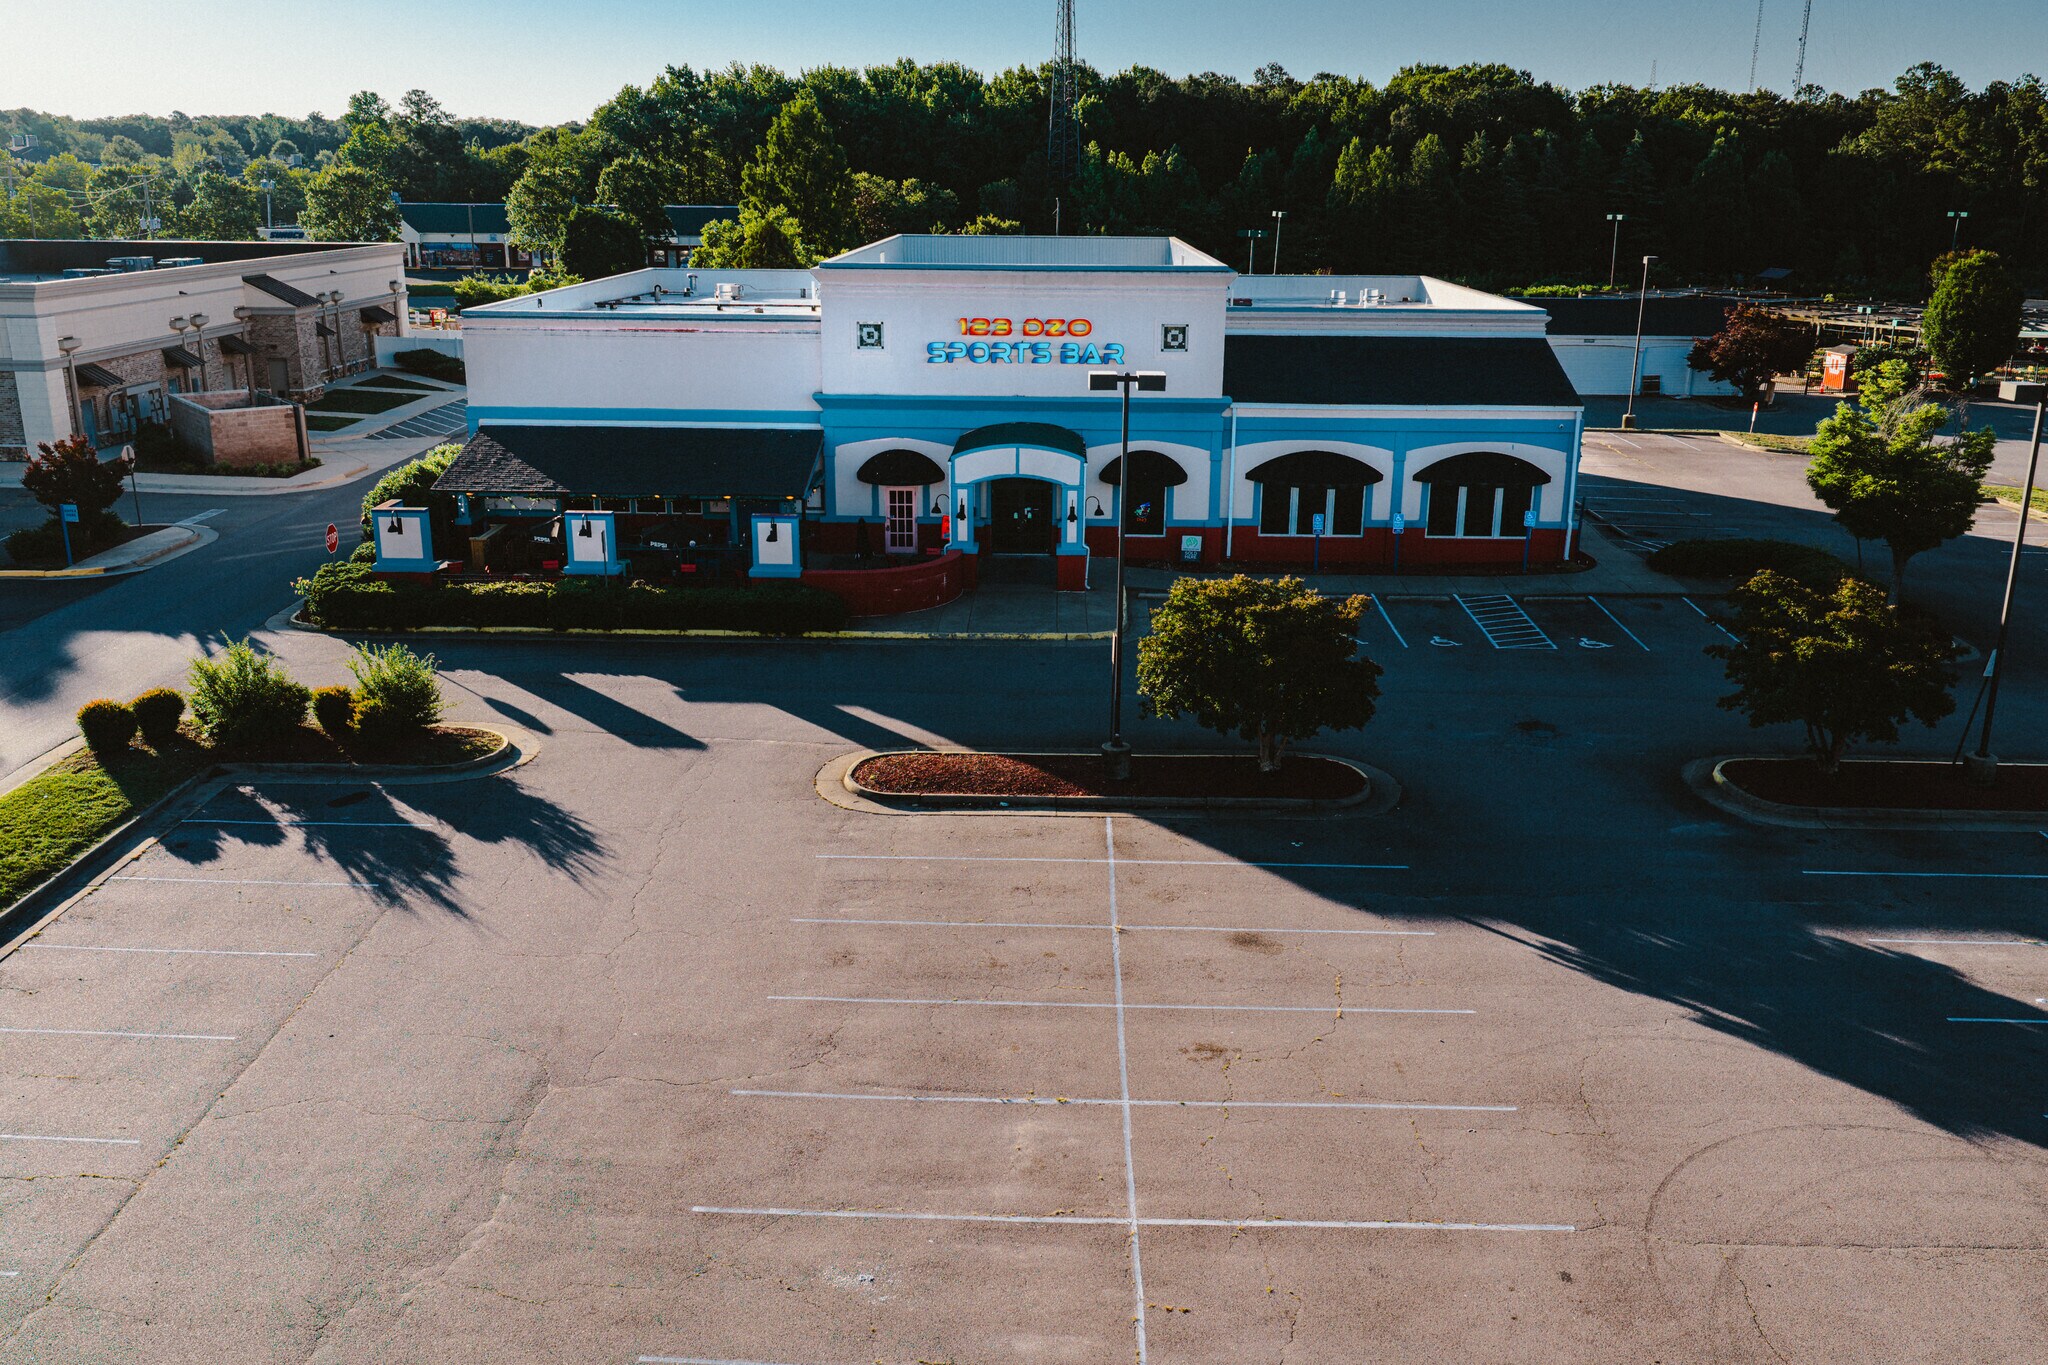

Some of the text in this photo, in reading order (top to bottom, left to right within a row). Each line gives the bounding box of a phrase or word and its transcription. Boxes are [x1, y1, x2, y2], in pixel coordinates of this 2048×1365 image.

[957, 317, 1093, 337] 123 DZO
[927, 341, 1125, 365] SPORTS BAR
[326, 532, 337, 545] STOP
